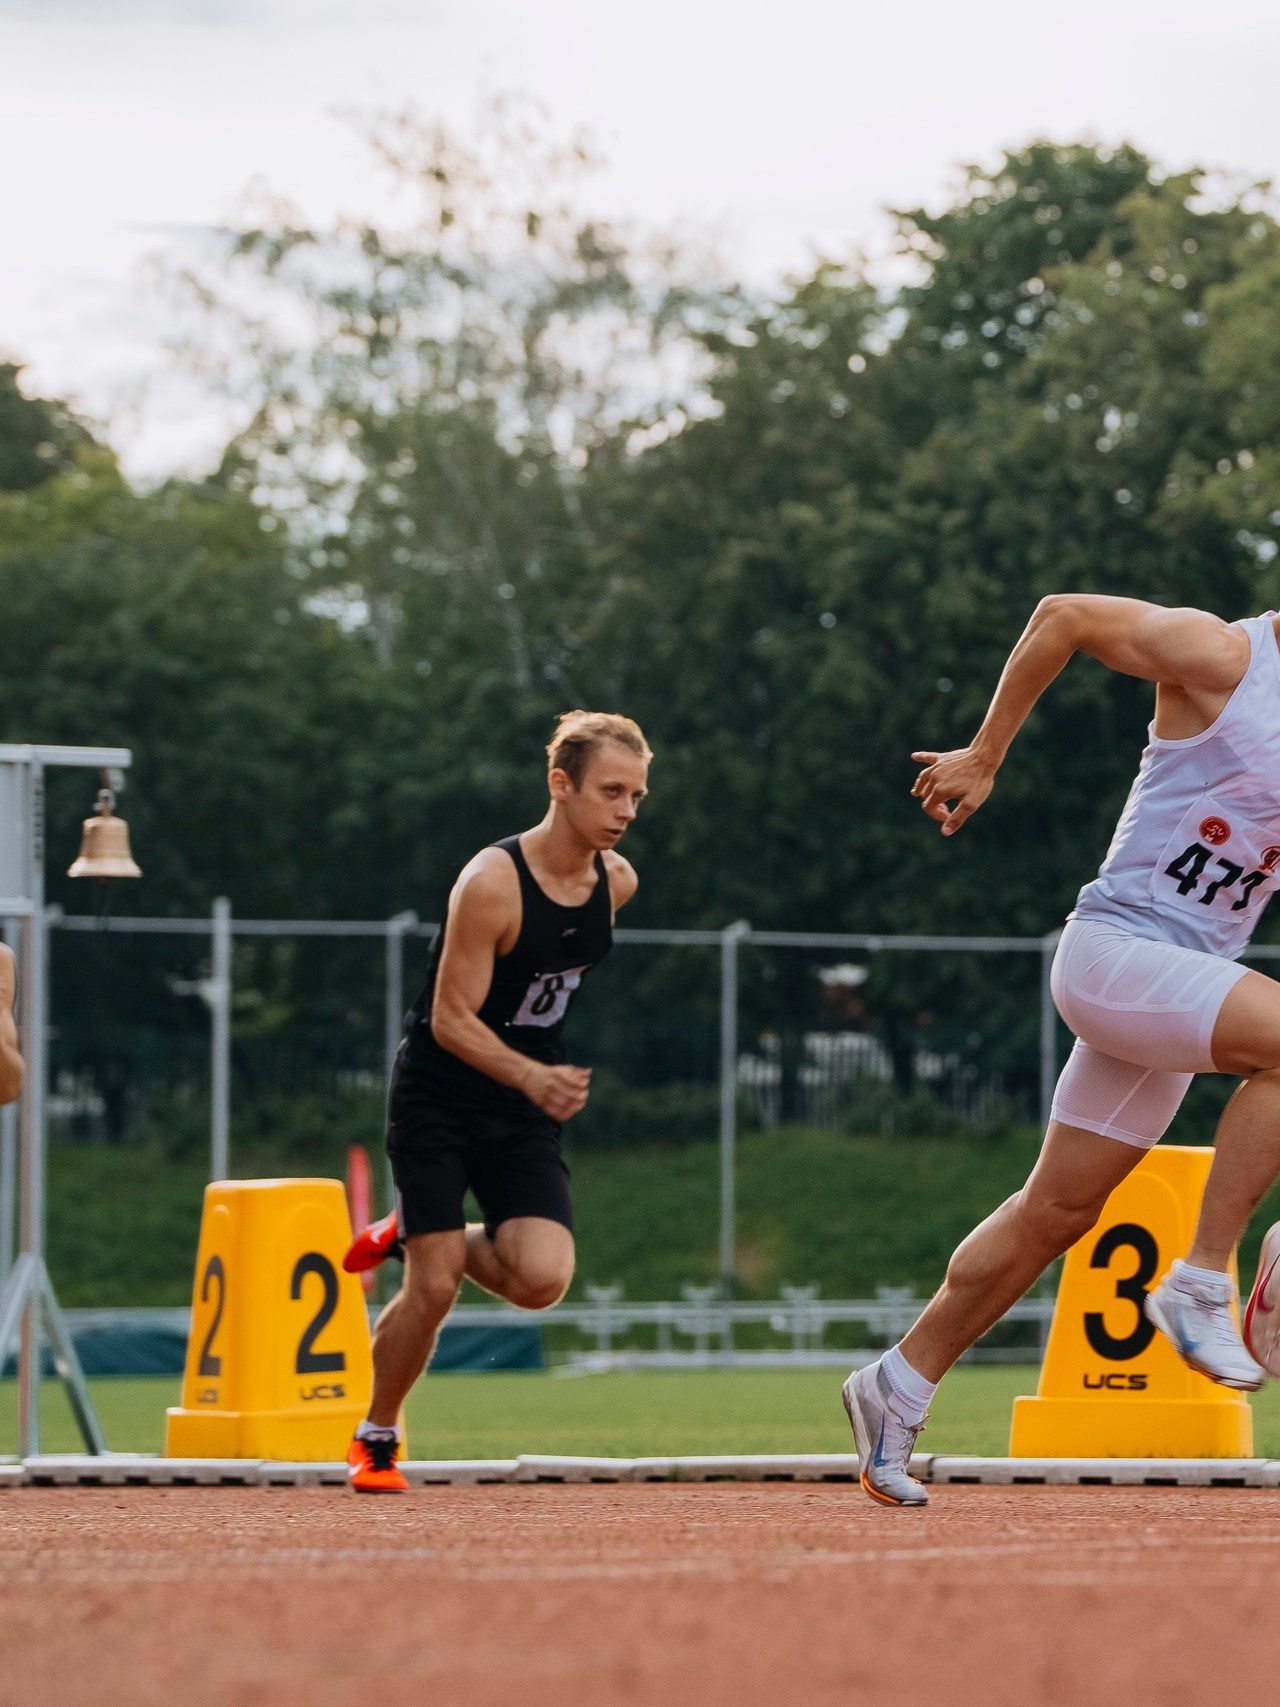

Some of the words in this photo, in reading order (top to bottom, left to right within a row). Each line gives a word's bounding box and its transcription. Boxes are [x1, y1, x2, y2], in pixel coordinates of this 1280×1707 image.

[1164, 842, 1269, 911] 471
[198, 1255, 226, 1376] 2
[290, 1251, 346, 1374] 2
[1083, 1223, 1160, 1361] 3
[301, 1384, 346, 1400] UCS
[1083, 1374, 1149, 1390] UCS
